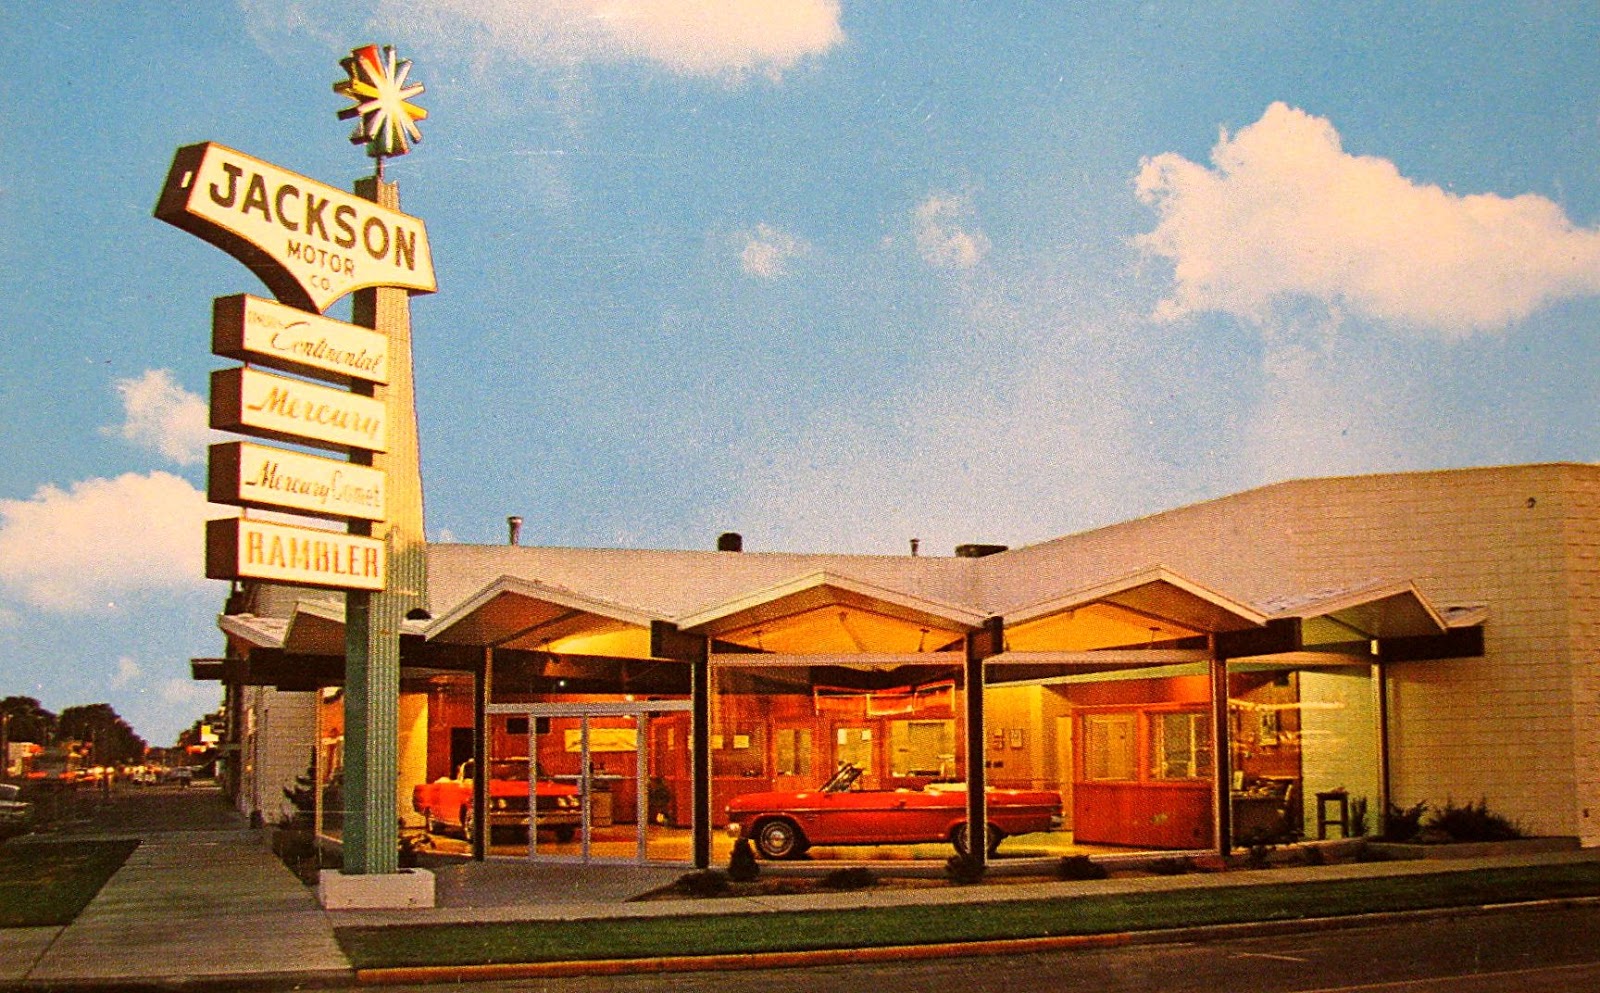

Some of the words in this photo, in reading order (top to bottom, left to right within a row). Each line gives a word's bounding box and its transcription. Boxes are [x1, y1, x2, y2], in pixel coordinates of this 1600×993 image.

[209, 162, 416, 271] JACKSON
[287, 239, 355, 277] MOTOR
[270, 321, 383, 374] Continental
[246, 385, 380, 440] Mercury
[245, 461, 331, 504] Mercury
[247, 531, 378, 578] RAMBLER
